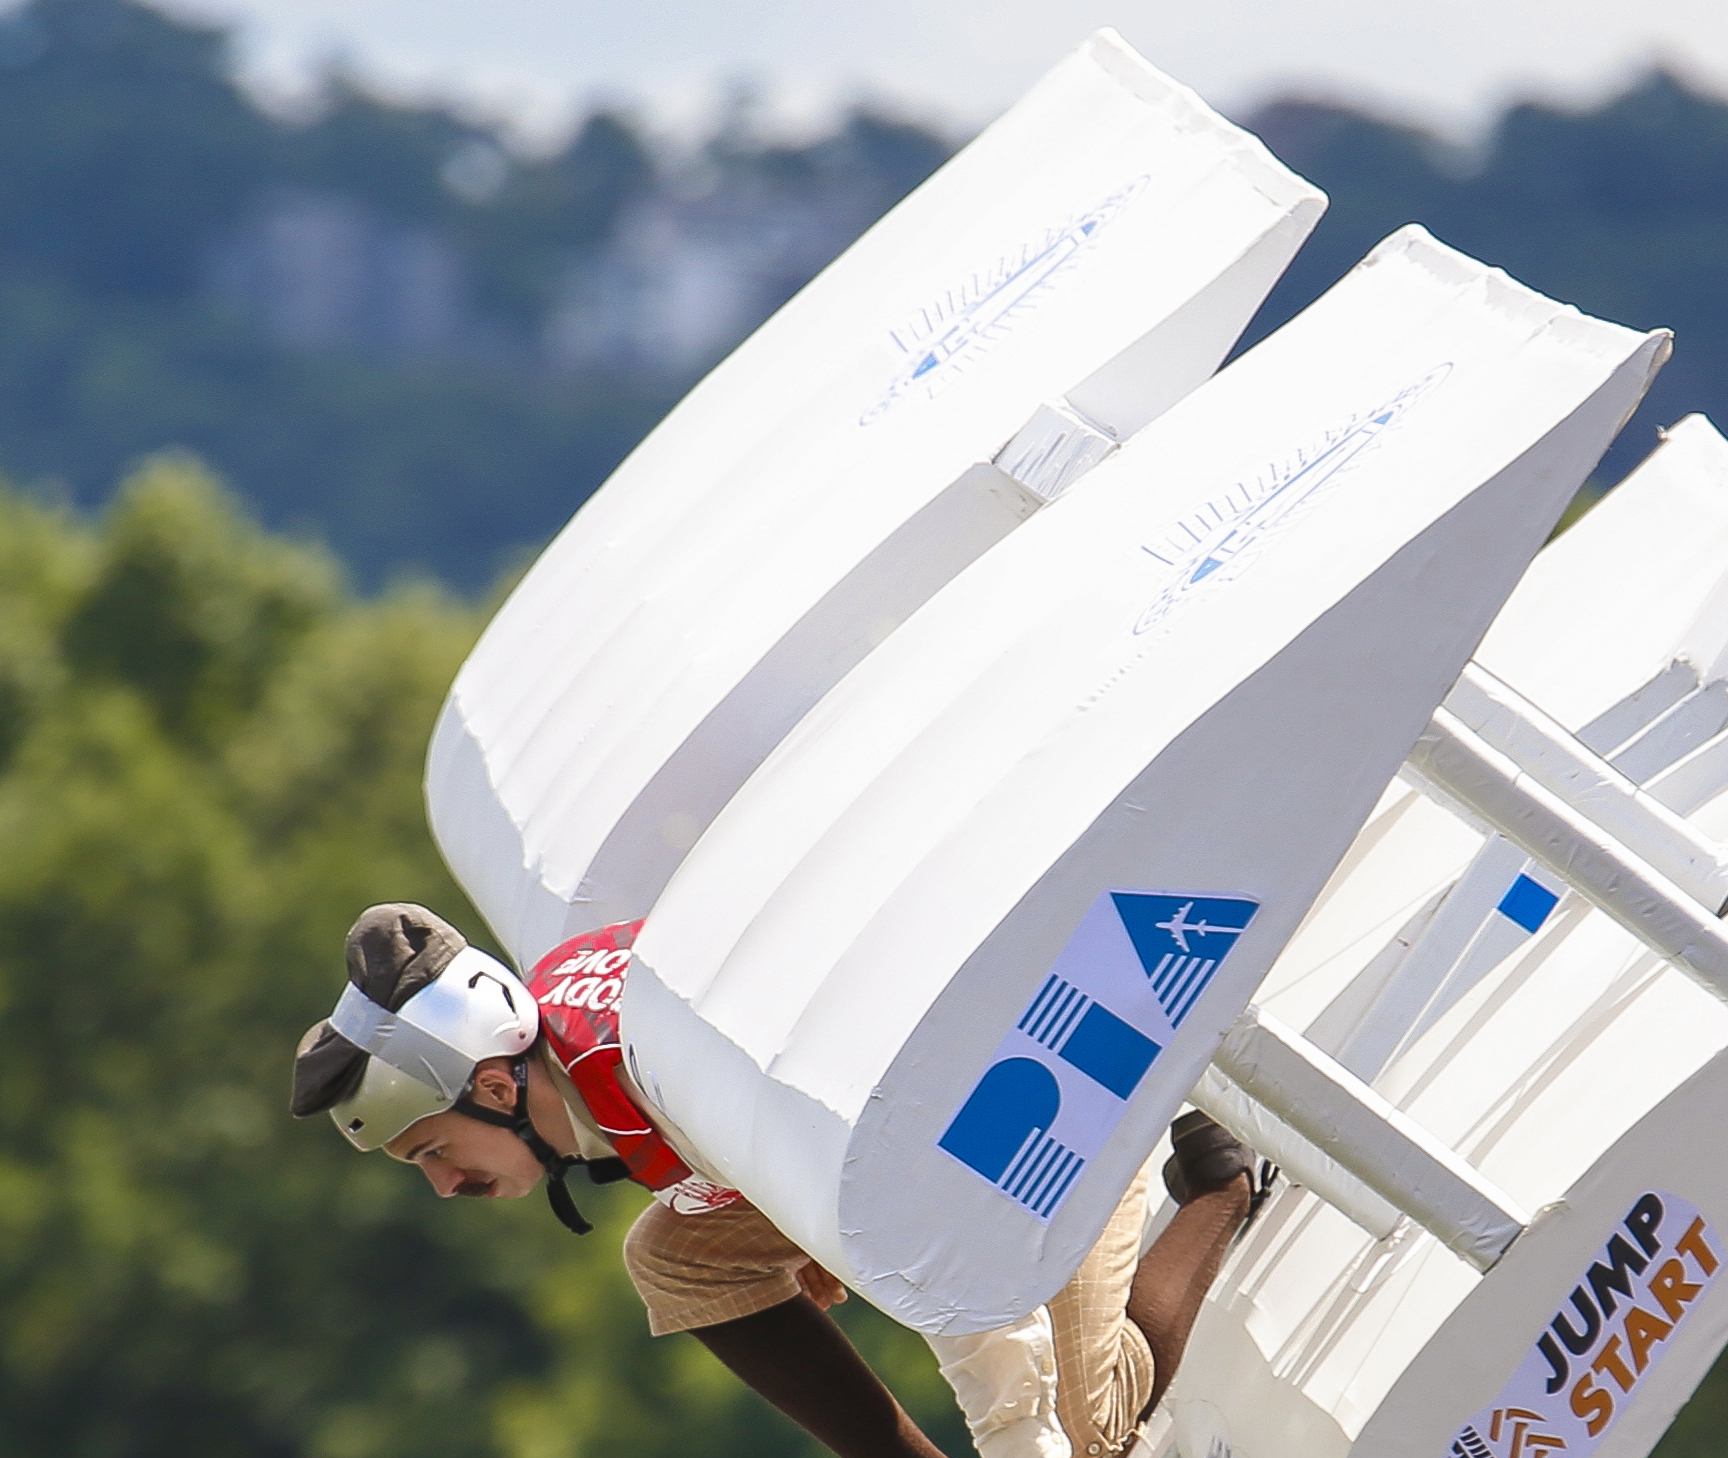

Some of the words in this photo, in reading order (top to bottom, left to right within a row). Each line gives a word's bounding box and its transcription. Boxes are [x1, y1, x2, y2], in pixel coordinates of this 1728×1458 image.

[538, 976, 623, 1012] ODY
[551, 949, 632, 979] OVE
[939, 892, 1258, 1222] PIA
[1544, 1192, 1666, 1394] JUMP
[1571, 1216, 1723, 1437] START
